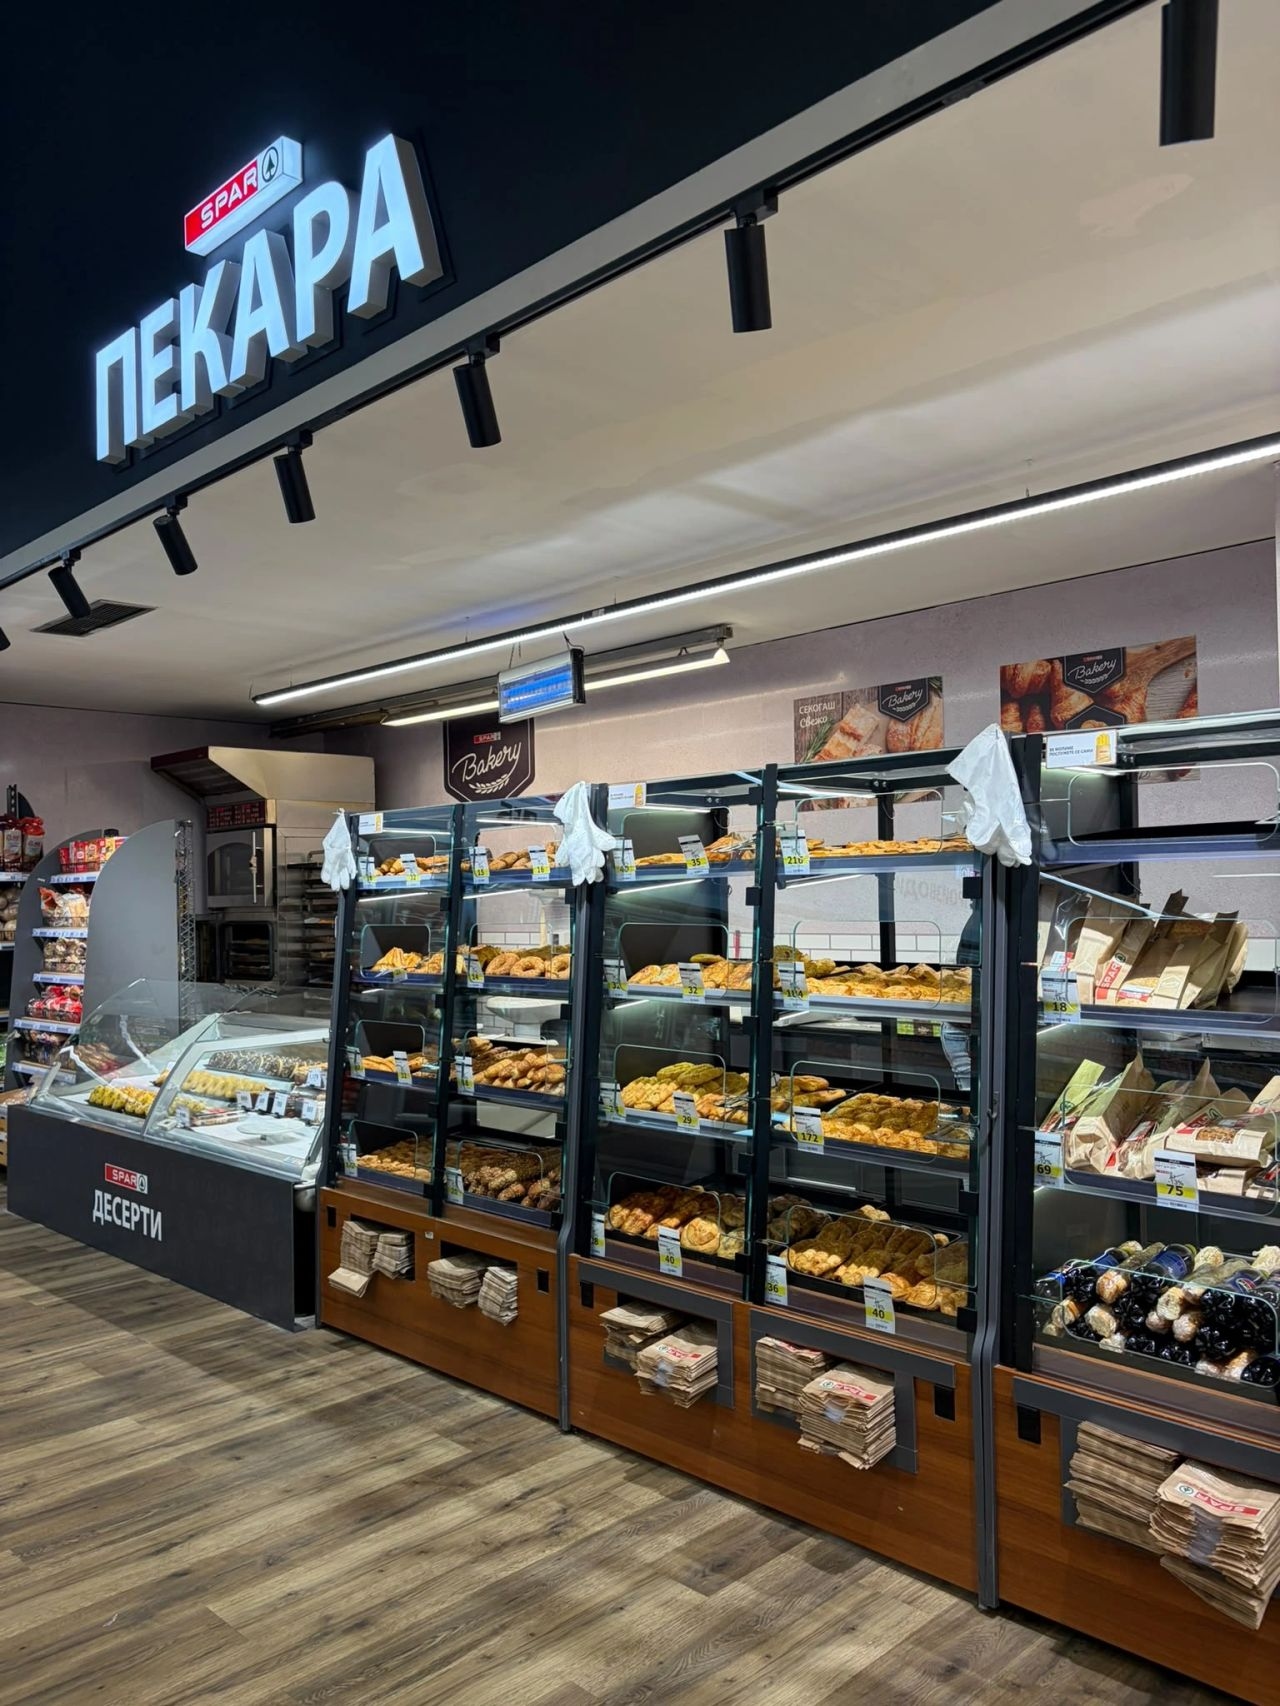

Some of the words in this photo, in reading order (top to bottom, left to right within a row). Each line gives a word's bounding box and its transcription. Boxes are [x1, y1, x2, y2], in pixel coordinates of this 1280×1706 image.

[201, 169, 258, 229] SPAR
[96, 133, 428, 462] ПЕКАРА
[1068, 659, 1117, 680] Bakery
[882, 688, 923, 708] Bakery
[799, 701, 836, 715] СЕКОГАШ
[452, 740, 522, 782] Bakery
[691, 858, 701, 867] 35
[1101, 963, 1119, 988] SPAR
[688, 986, 698, 995] 32
[1052, 1002, 1067, 1012] 18
[682, 1115, 692, 1124] 29
[801, 1133, 819, 1143] 172
[1037, 1164, 1051, 1175] 69
[112, 1169, 137, 1187] SPAR
[1166, 1184, 1184, 1196] 75
[92, 1190, 162, 1241] ДЕСЕРТИ
[665, 1256, 674, 1264] 40
[767, 1283, 778, 1292] 36
[872, 1308, 885, 1319] 40
[1196, 1492, 1246, 1512] SPAR
